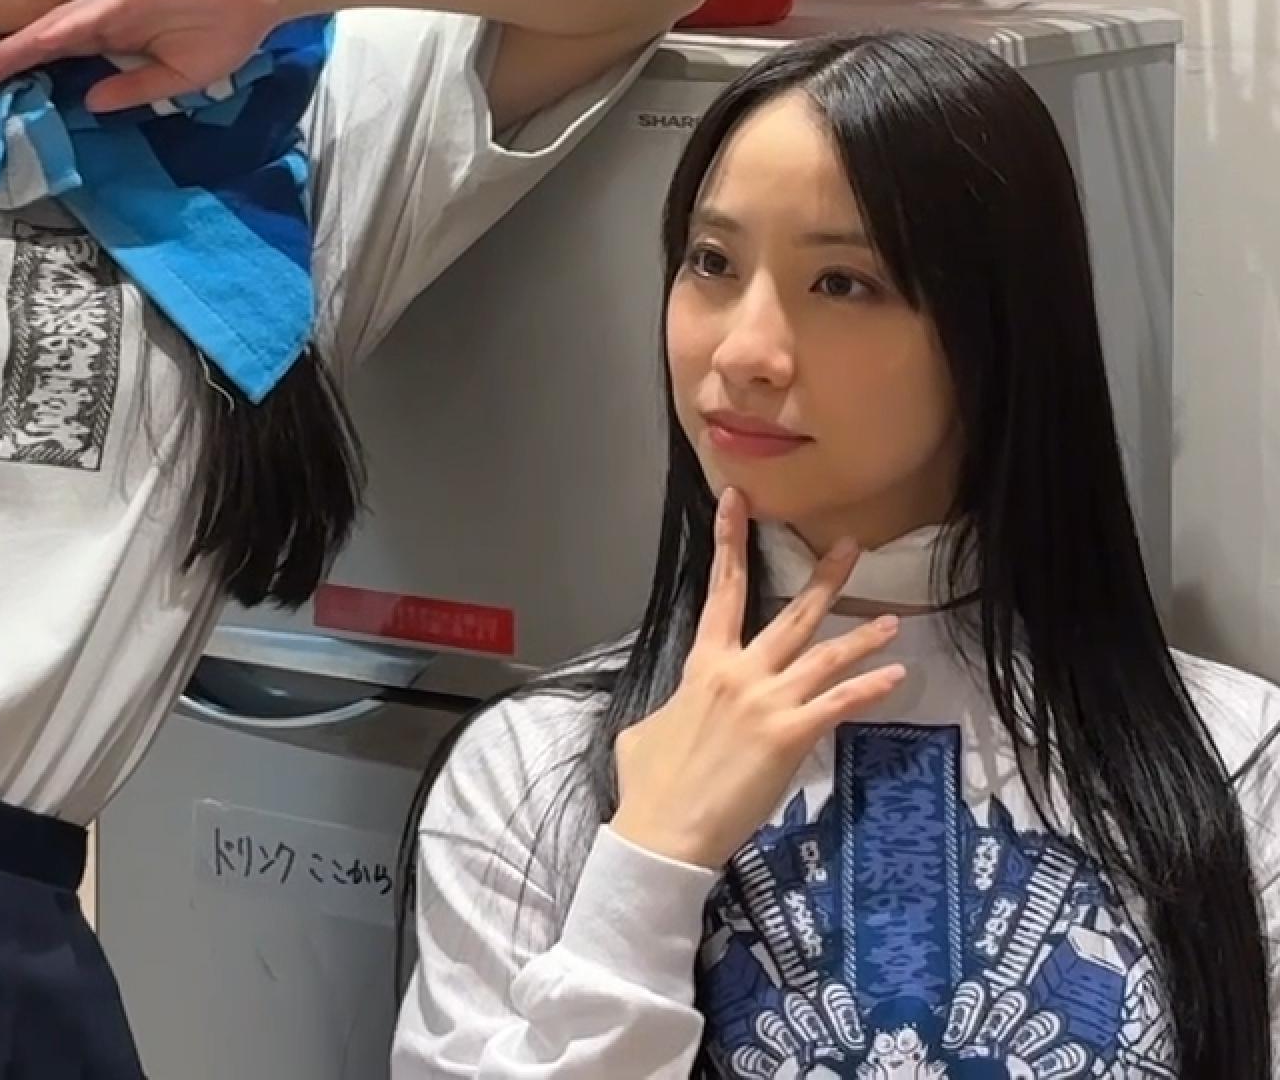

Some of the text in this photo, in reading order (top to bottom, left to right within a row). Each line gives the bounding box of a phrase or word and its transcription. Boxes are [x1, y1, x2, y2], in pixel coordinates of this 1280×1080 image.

[215, 826, 393, 896] ドリンク ここから
